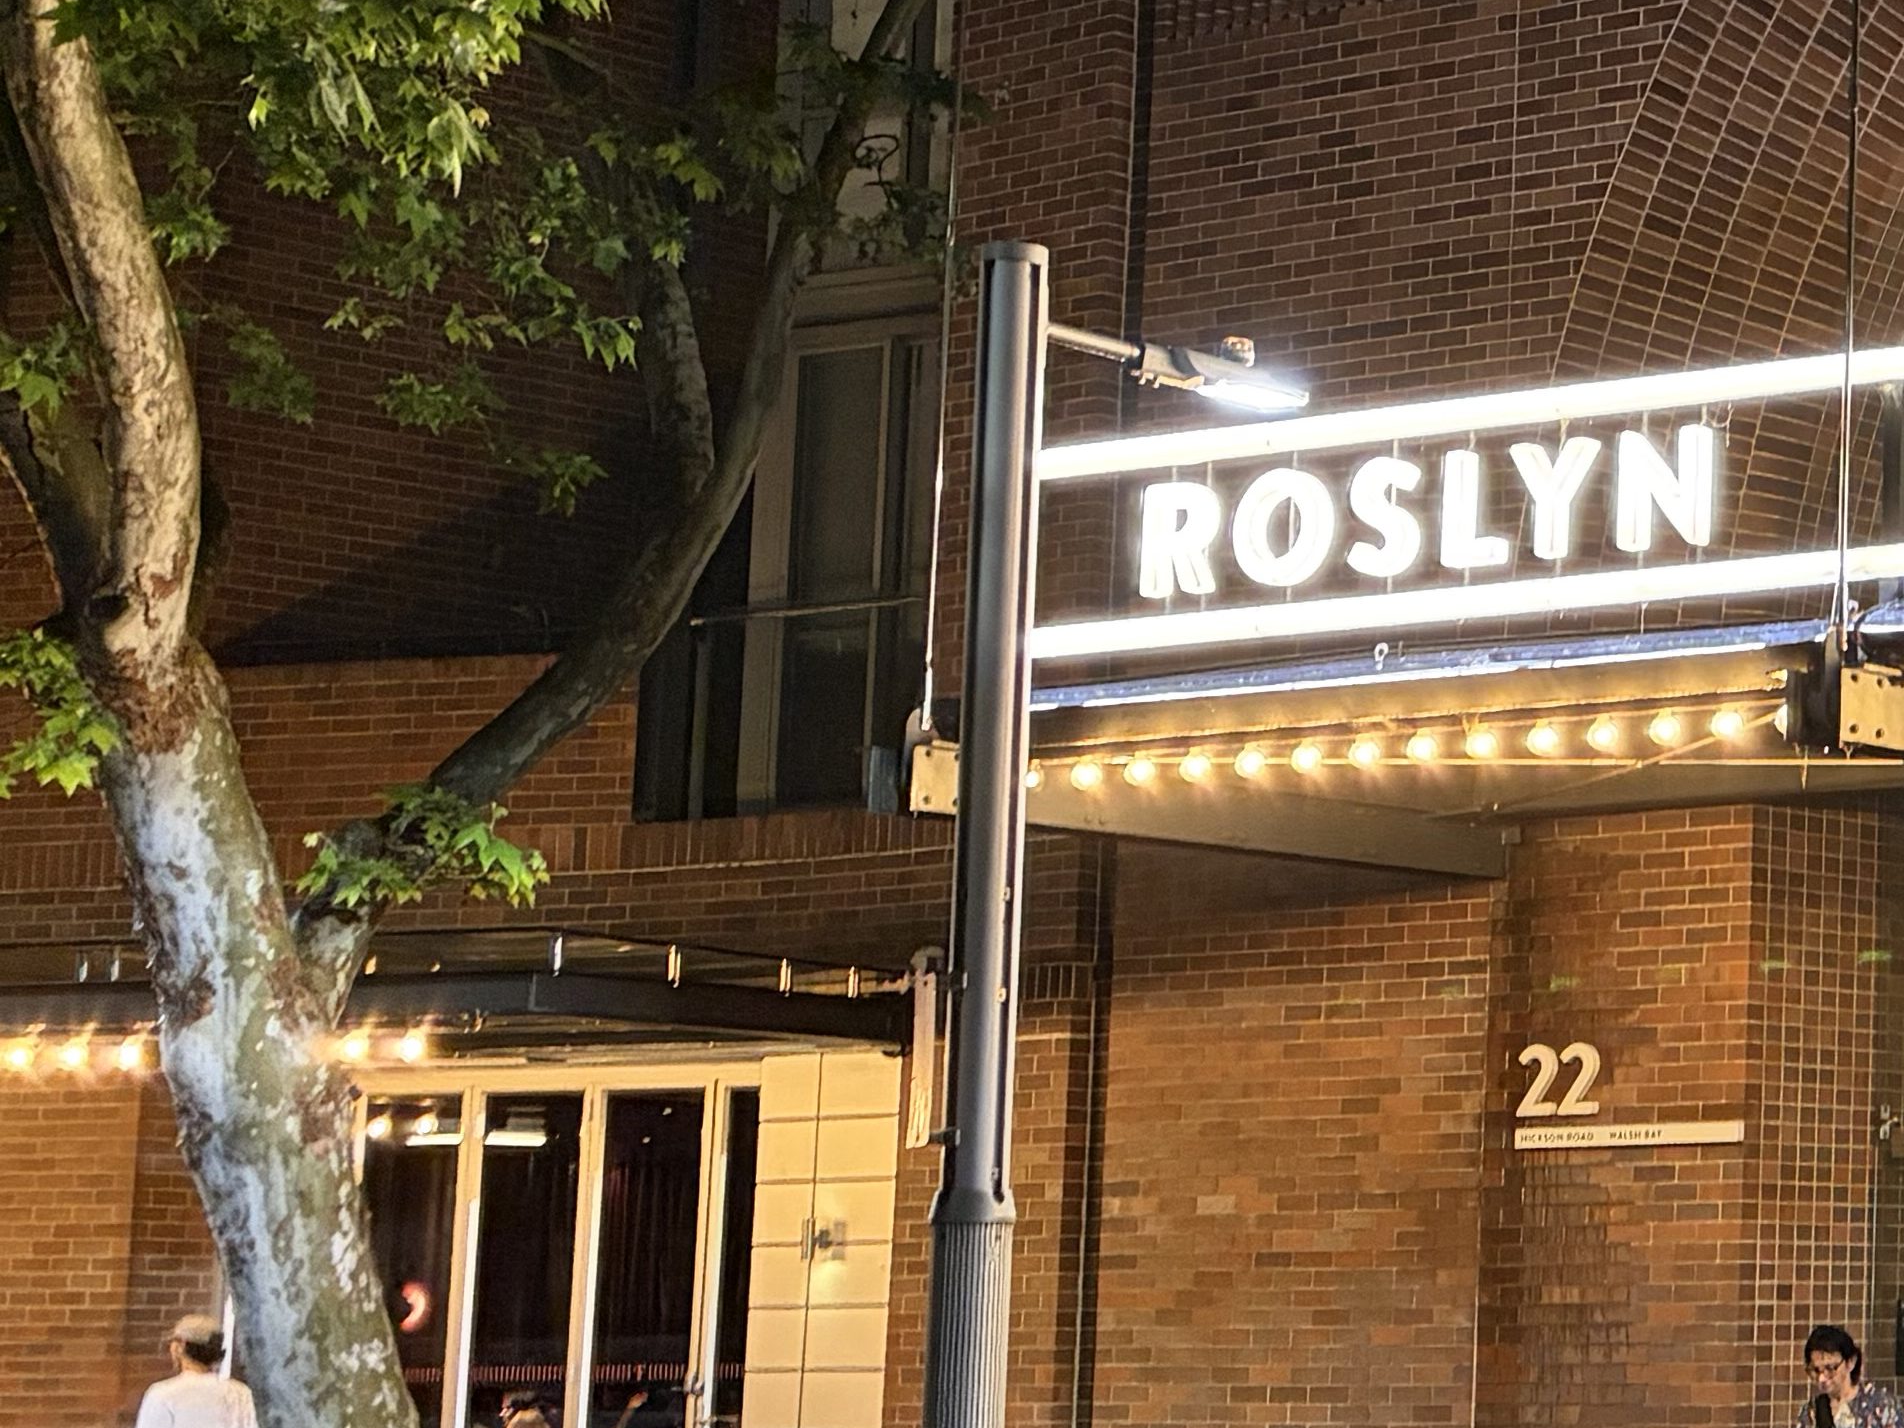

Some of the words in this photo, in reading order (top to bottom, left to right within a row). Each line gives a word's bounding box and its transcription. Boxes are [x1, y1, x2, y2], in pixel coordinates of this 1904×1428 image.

[1138, 423, 1714, 600] ROSLYN
[1515, 1041, 1601, 1118] 22
[1566, 1132, 1595, 1143] ROAD
[1609, 1130, 1642, 1141] WALSH
[1643, 1129, 1662, 1140] BAY
